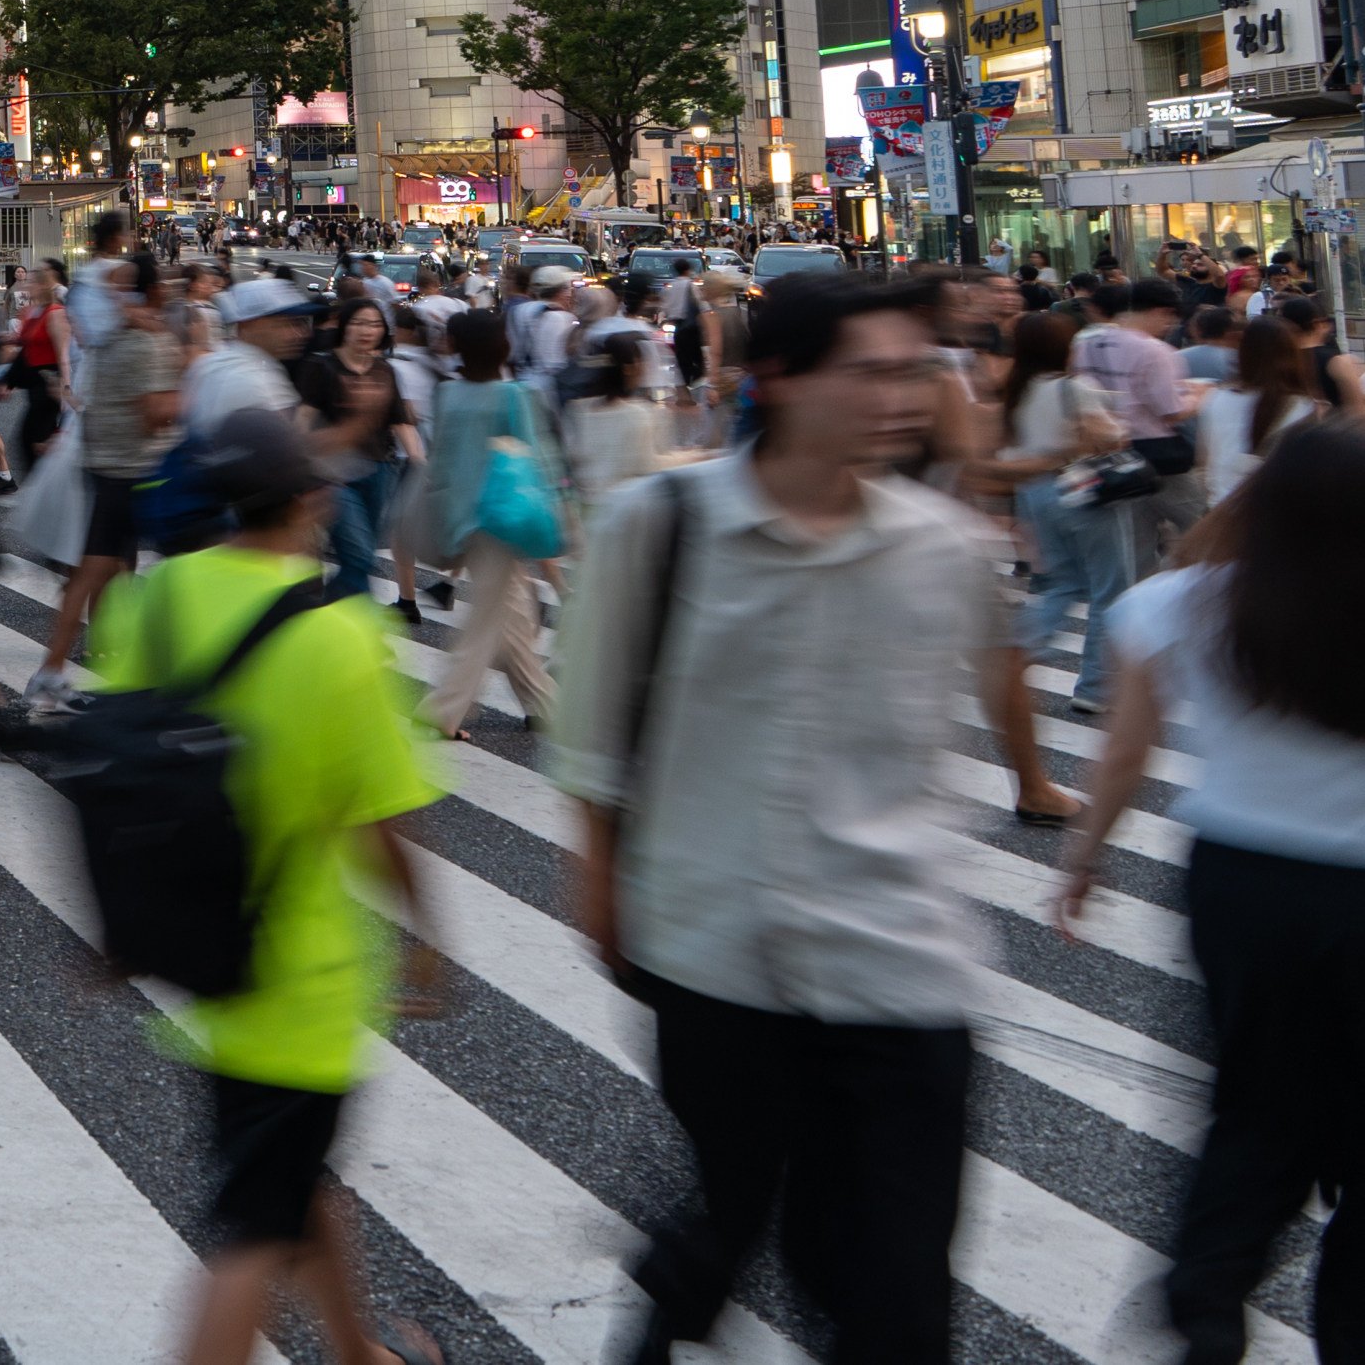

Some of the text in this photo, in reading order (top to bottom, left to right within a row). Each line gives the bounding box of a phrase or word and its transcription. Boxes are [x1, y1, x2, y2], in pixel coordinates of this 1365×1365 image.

[929, 128, 947, 200] 文化村通り
[438, 181, 471, 201] 109
